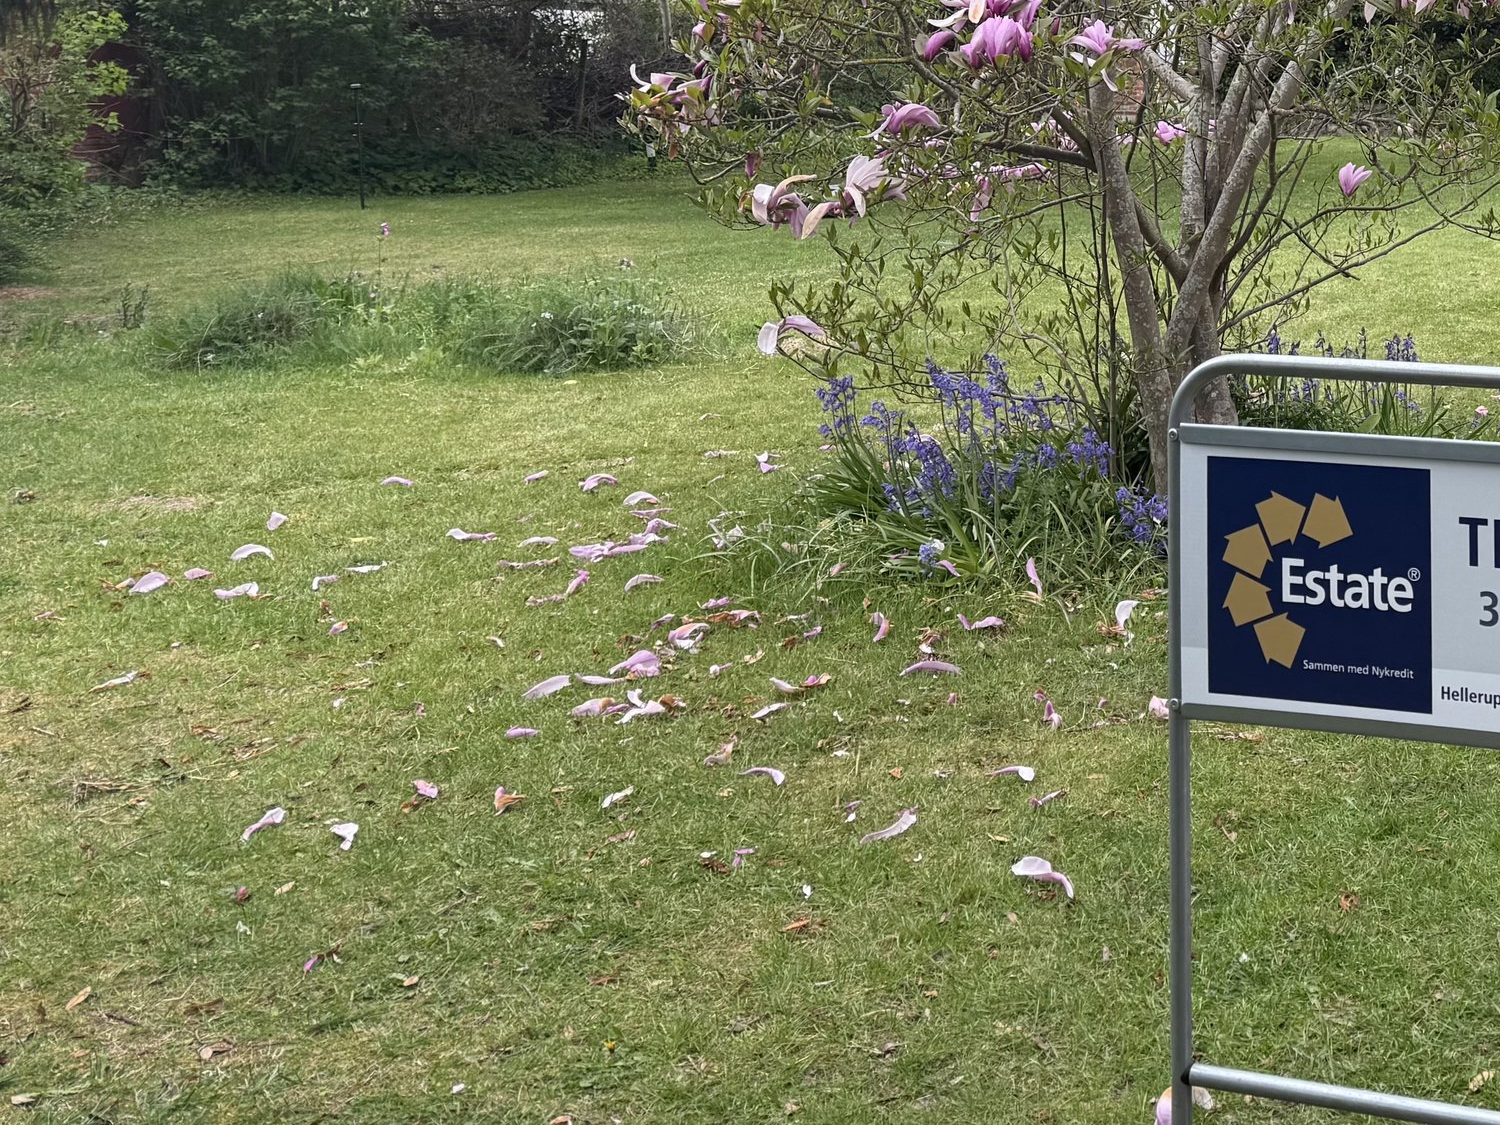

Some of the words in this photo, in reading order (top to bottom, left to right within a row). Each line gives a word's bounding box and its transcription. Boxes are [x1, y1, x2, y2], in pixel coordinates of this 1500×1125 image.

[1303, 660, 1345, 673] Sammen
[1347, 664, 1369, 675] med
[1371, 666, 1414, 679] Nykredit
